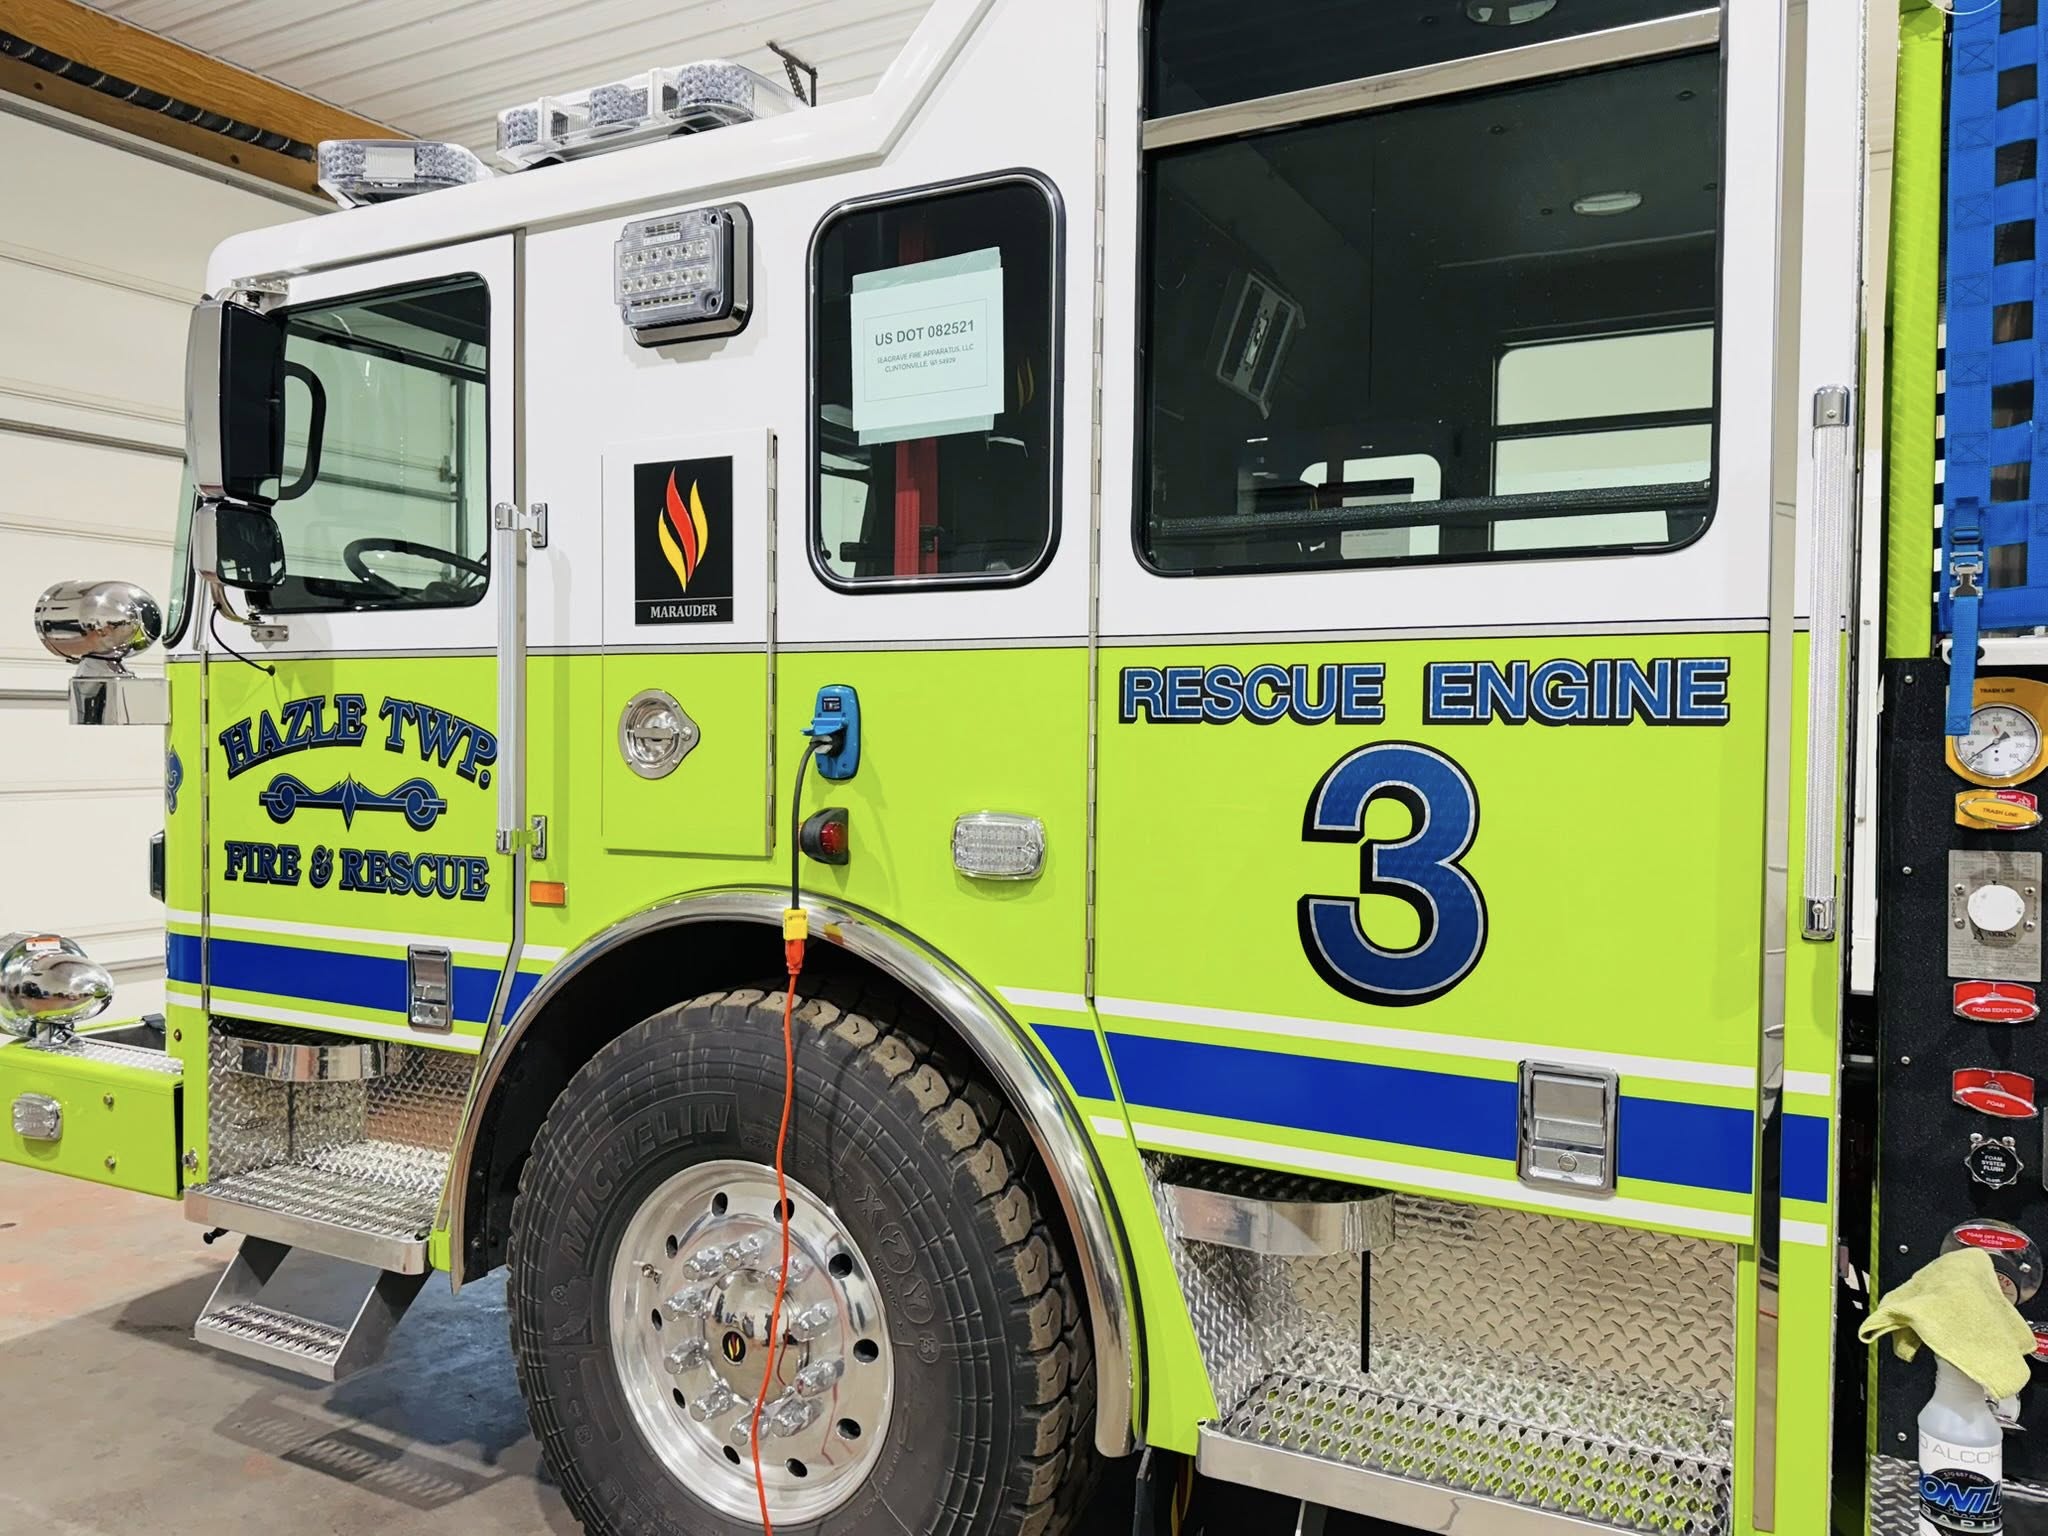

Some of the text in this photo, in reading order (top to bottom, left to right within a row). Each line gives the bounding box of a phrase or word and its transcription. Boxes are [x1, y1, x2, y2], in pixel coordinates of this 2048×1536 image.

[875, 319, 974, 346] US DOT 082521
[908, 350, 921, 359] FIRE
[961, 343, 974, 351] LLC
[650, 603, 717, 618] MARAUDER
[1118, 656, 1731, 727] RESCUE ENGINE
[219, 694, 498, 790] HAZLE TWP.
[224, 840, 491, 902] FIRE & RESCUE
[1297, 739, 1489, 1008] 3
[1986, 1099, 2005, 1108] FOAM
[558, 1103, 732, 1264] MICHELIN
